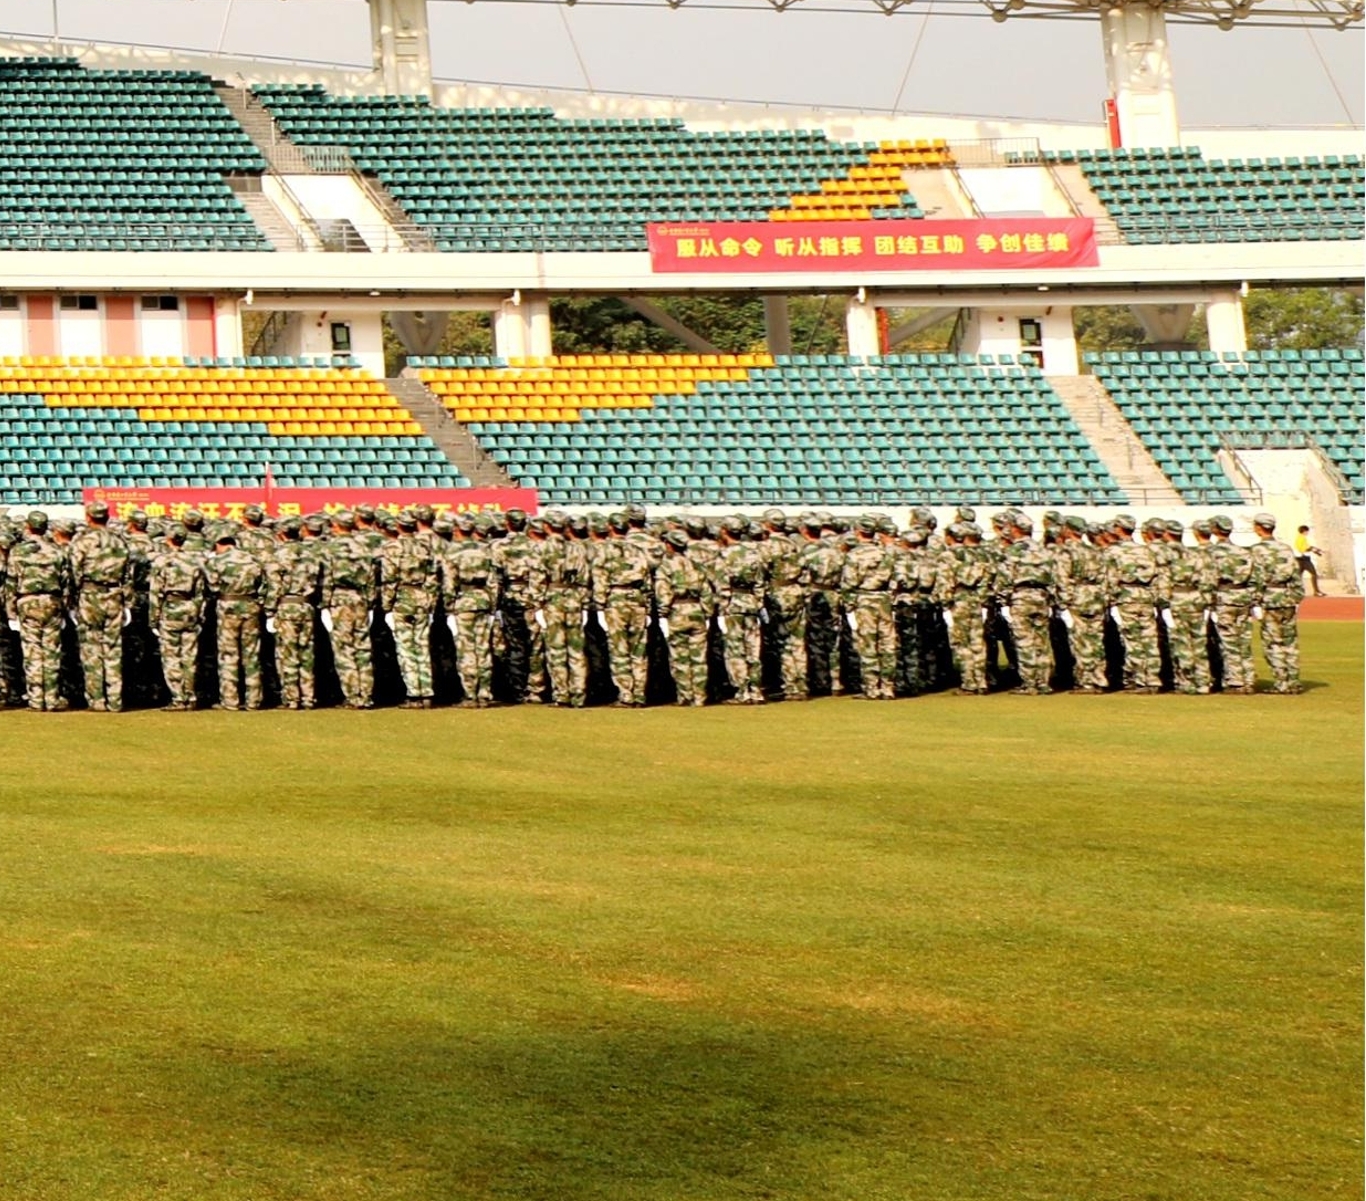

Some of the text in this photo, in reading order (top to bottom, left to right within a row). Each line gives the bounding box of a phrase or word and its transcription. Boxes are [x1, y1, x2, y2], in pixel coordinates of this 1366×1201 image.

[676, 232, 1069, 258] 服从命令 听从指挥 团结互助 争创佳绩
